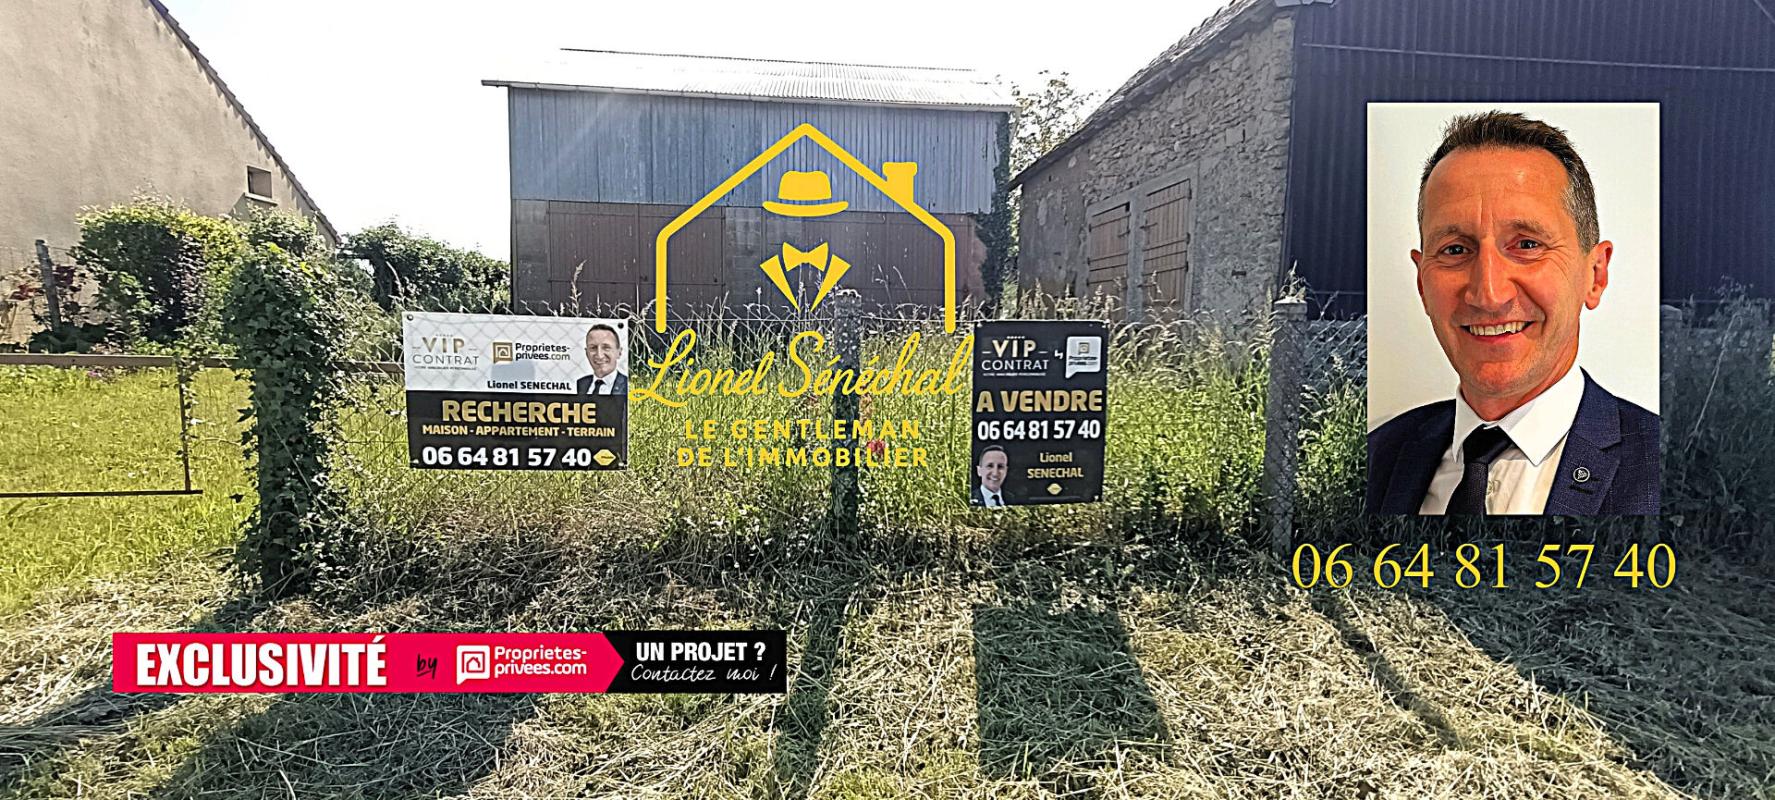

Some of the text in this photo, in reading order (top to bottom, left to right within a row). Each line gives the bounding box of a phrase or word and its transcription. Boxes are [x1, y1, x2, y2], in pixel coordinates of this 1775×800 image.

[422, 337, 465, 353] VIP
[992, 340, 1036, 358] VIP
[412, 354, 479, 365] CONTRAT
[515, 351, 571, 361] privees.com
[981, 360, 1049, 371] CONTRAT
[487, 380, 572, 390] Lionel SENECHAL
[976, 390, 1103, 413] A VENDRE
[442, 400, 597, 424] RECHERCHE
[422, 424, 468, 435] MAISON
[476, 426, 558, 436] APPARTEMENT
[567, 427, 616, 437] TERRAIN
[977, 419, 1100, 440] 06 64 81 57 40
[422, 446, 592, 467] 06 64 81 57 40
[1040, 451, 1073, 463] Lionel
[1027, 467, 1085, 479] SENECHAL
